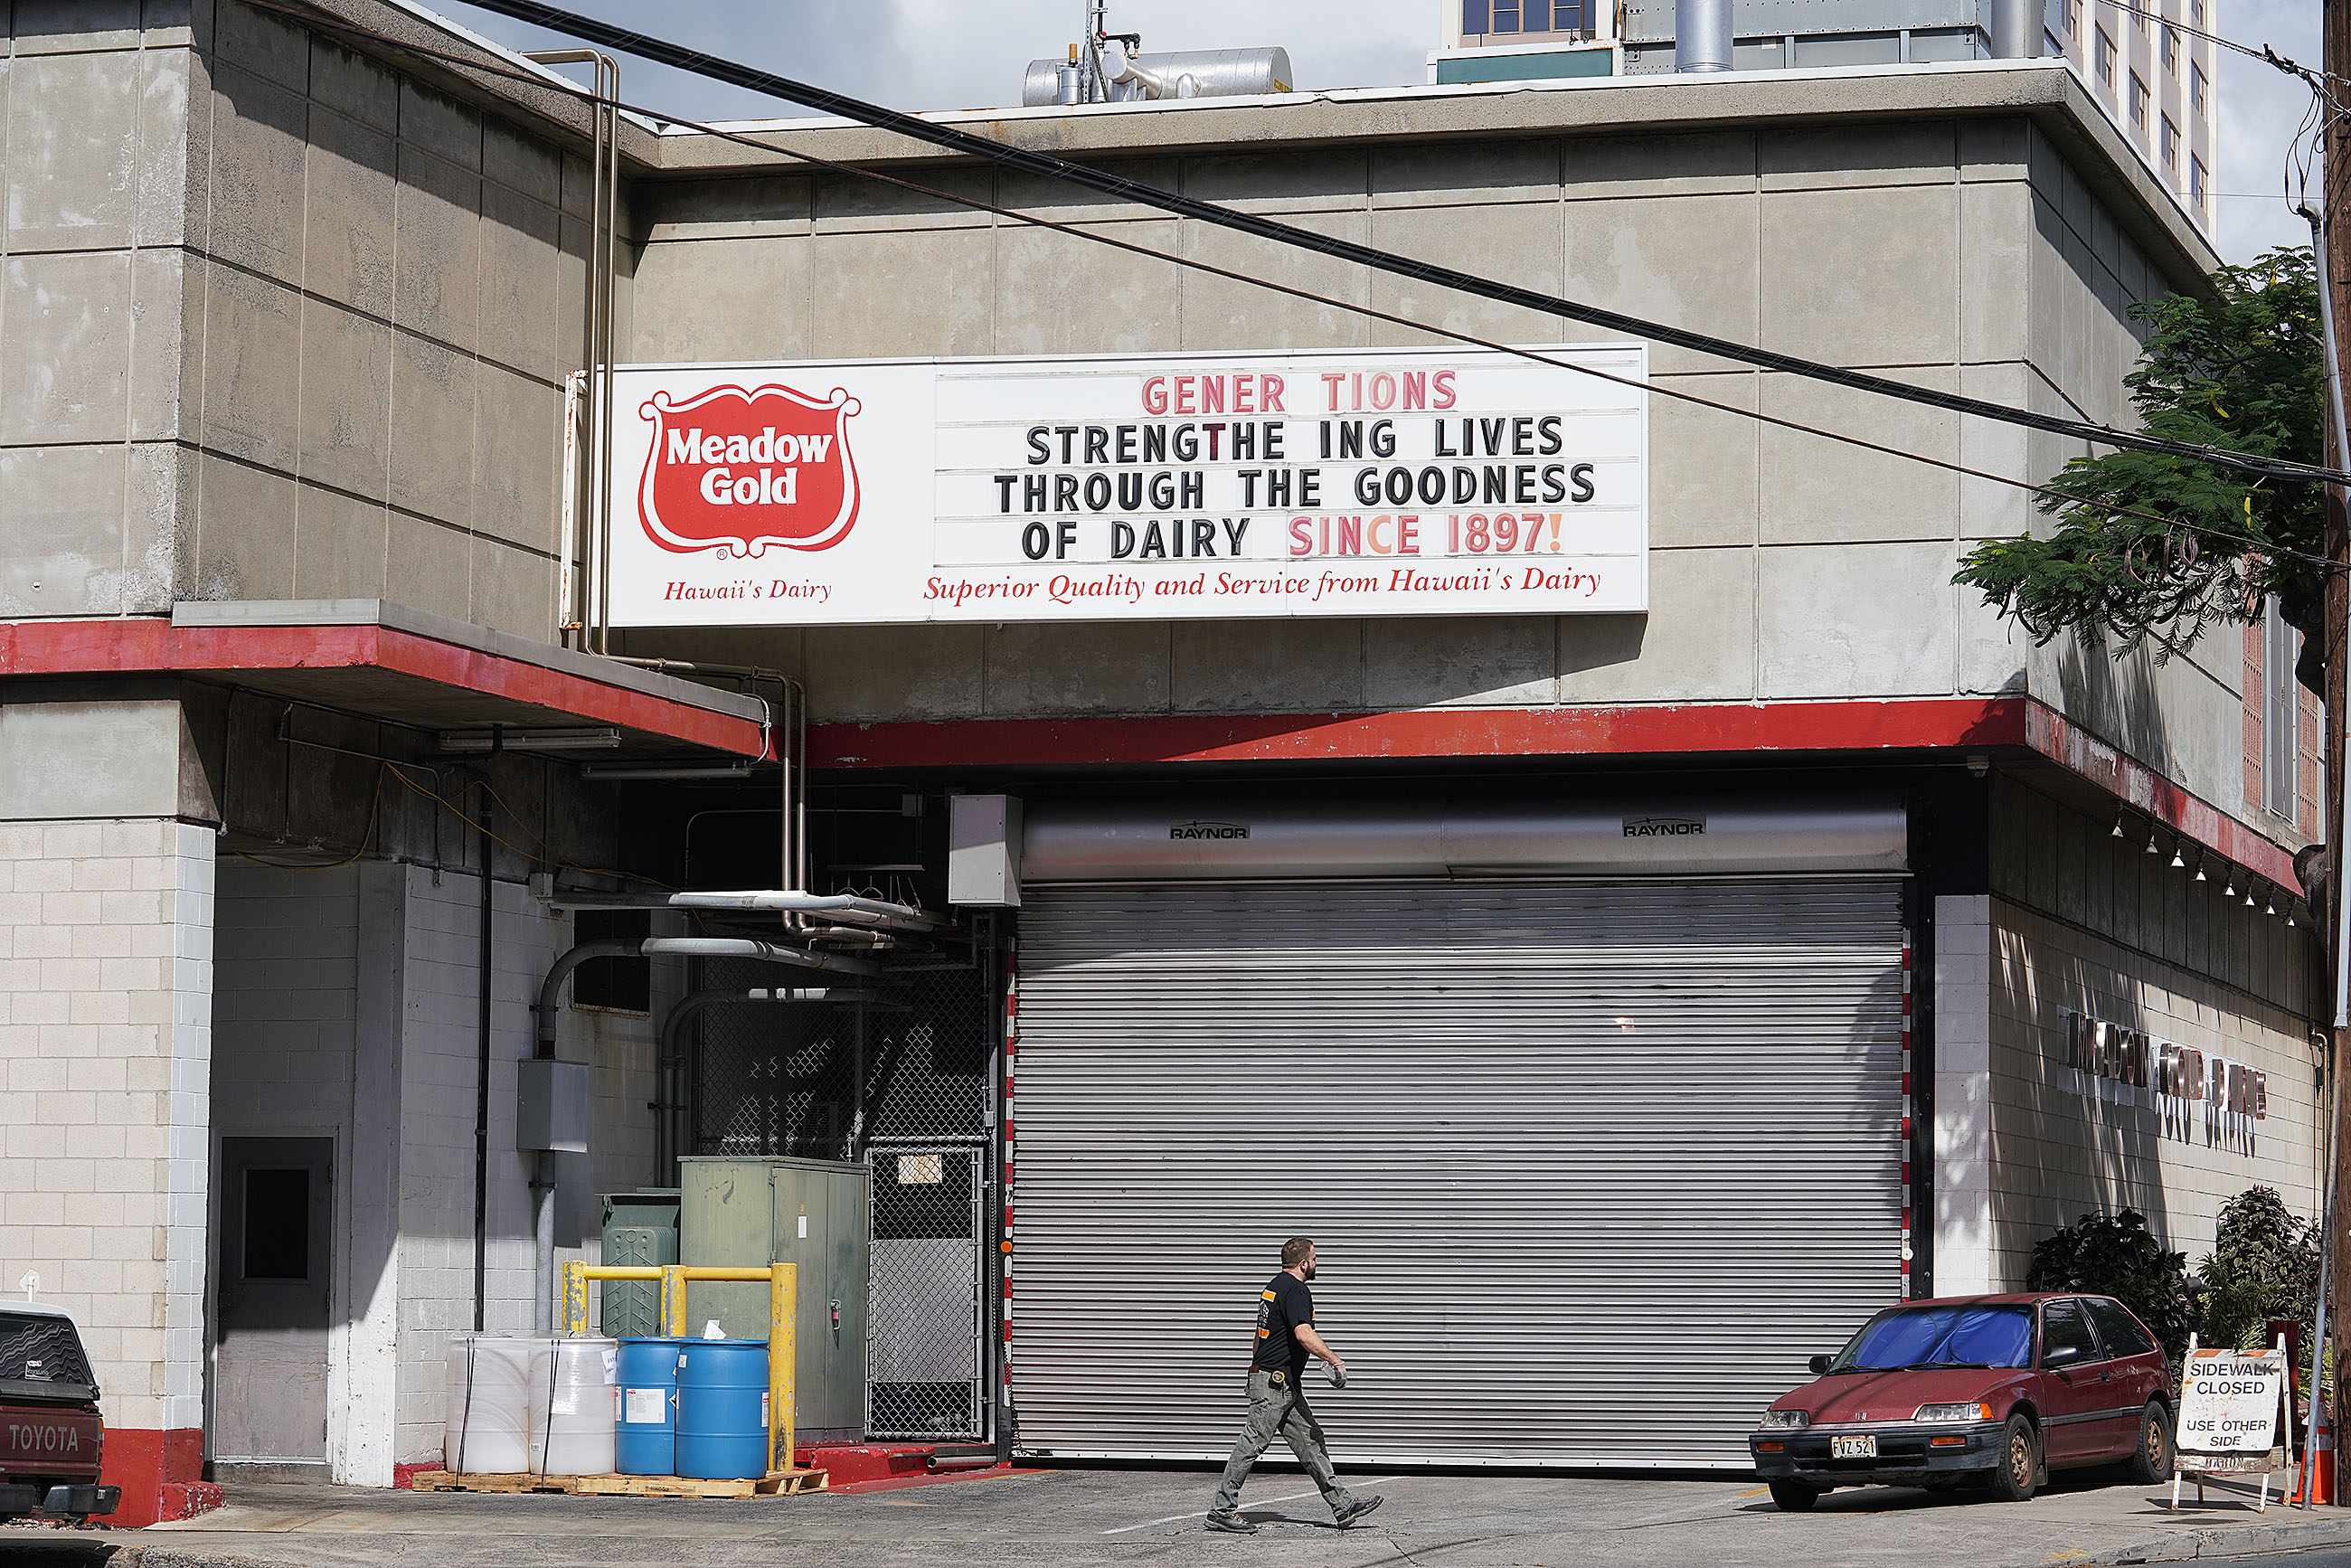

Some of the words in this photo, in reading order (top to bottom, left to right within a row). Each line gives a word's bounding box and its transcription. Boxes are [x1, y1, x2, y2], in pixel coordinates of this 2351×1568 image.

[1142, 374, 1285, 415] GENER
[1322, 370, 1456, 411] TIONS
[666, 427, 834, 465] Meadow
[1027, 422, 1284, 466] STRENGTHE
[1320, 420, 1395, 458] ING
[1436, 416, 1562, 457] LIVES
[699, 467, 798, 505] Gold
[995, 472, 1203, 514] THROUGH
[1238, 469, 1320, 507] THE
[1355, 463, 1594, 505] GOODNESS
[1023, 522, 1076, 560] OF
[1111, 518, 1250, 558] DAIRY
[1290, 515, 1420, 555] SINCE
[1449, 514, 1562, 553] 1897!
[665, 580, 762, 601] Hawaii's
[769, 580, 831, 603] Dairy
[924, 576, 1039, 607] Superior
[1049, 574, 1145, 604] Quality
[1156, 573, 1204, 595] and
[1214, 571, 1309, 594] Service
[1312, 571, 1377, 600] from
[1389, 568, 1512, 590] Hawaii's
[1521, 567, 1600, 597] Dairy
[1171, 828, 1247, 839] RAYNOR
[1624, 824, 1704, 837] RAYNOR
[2190, 1364, 2273, 1375] SIDEWALK
[2196, 1382, 2264, 1394] CLOSED
[9, 1425, 78, 1451] TOYOTA
[2186, 1421, 2215, 1431] USE
[2222, 1421, 2268, 1431] OTHER
[1833, 1441, 1853, 1454] FVZ
[1856, 1440, 1874, 1454] 521
[2209, 1436, 2242, 1447] SIDE
